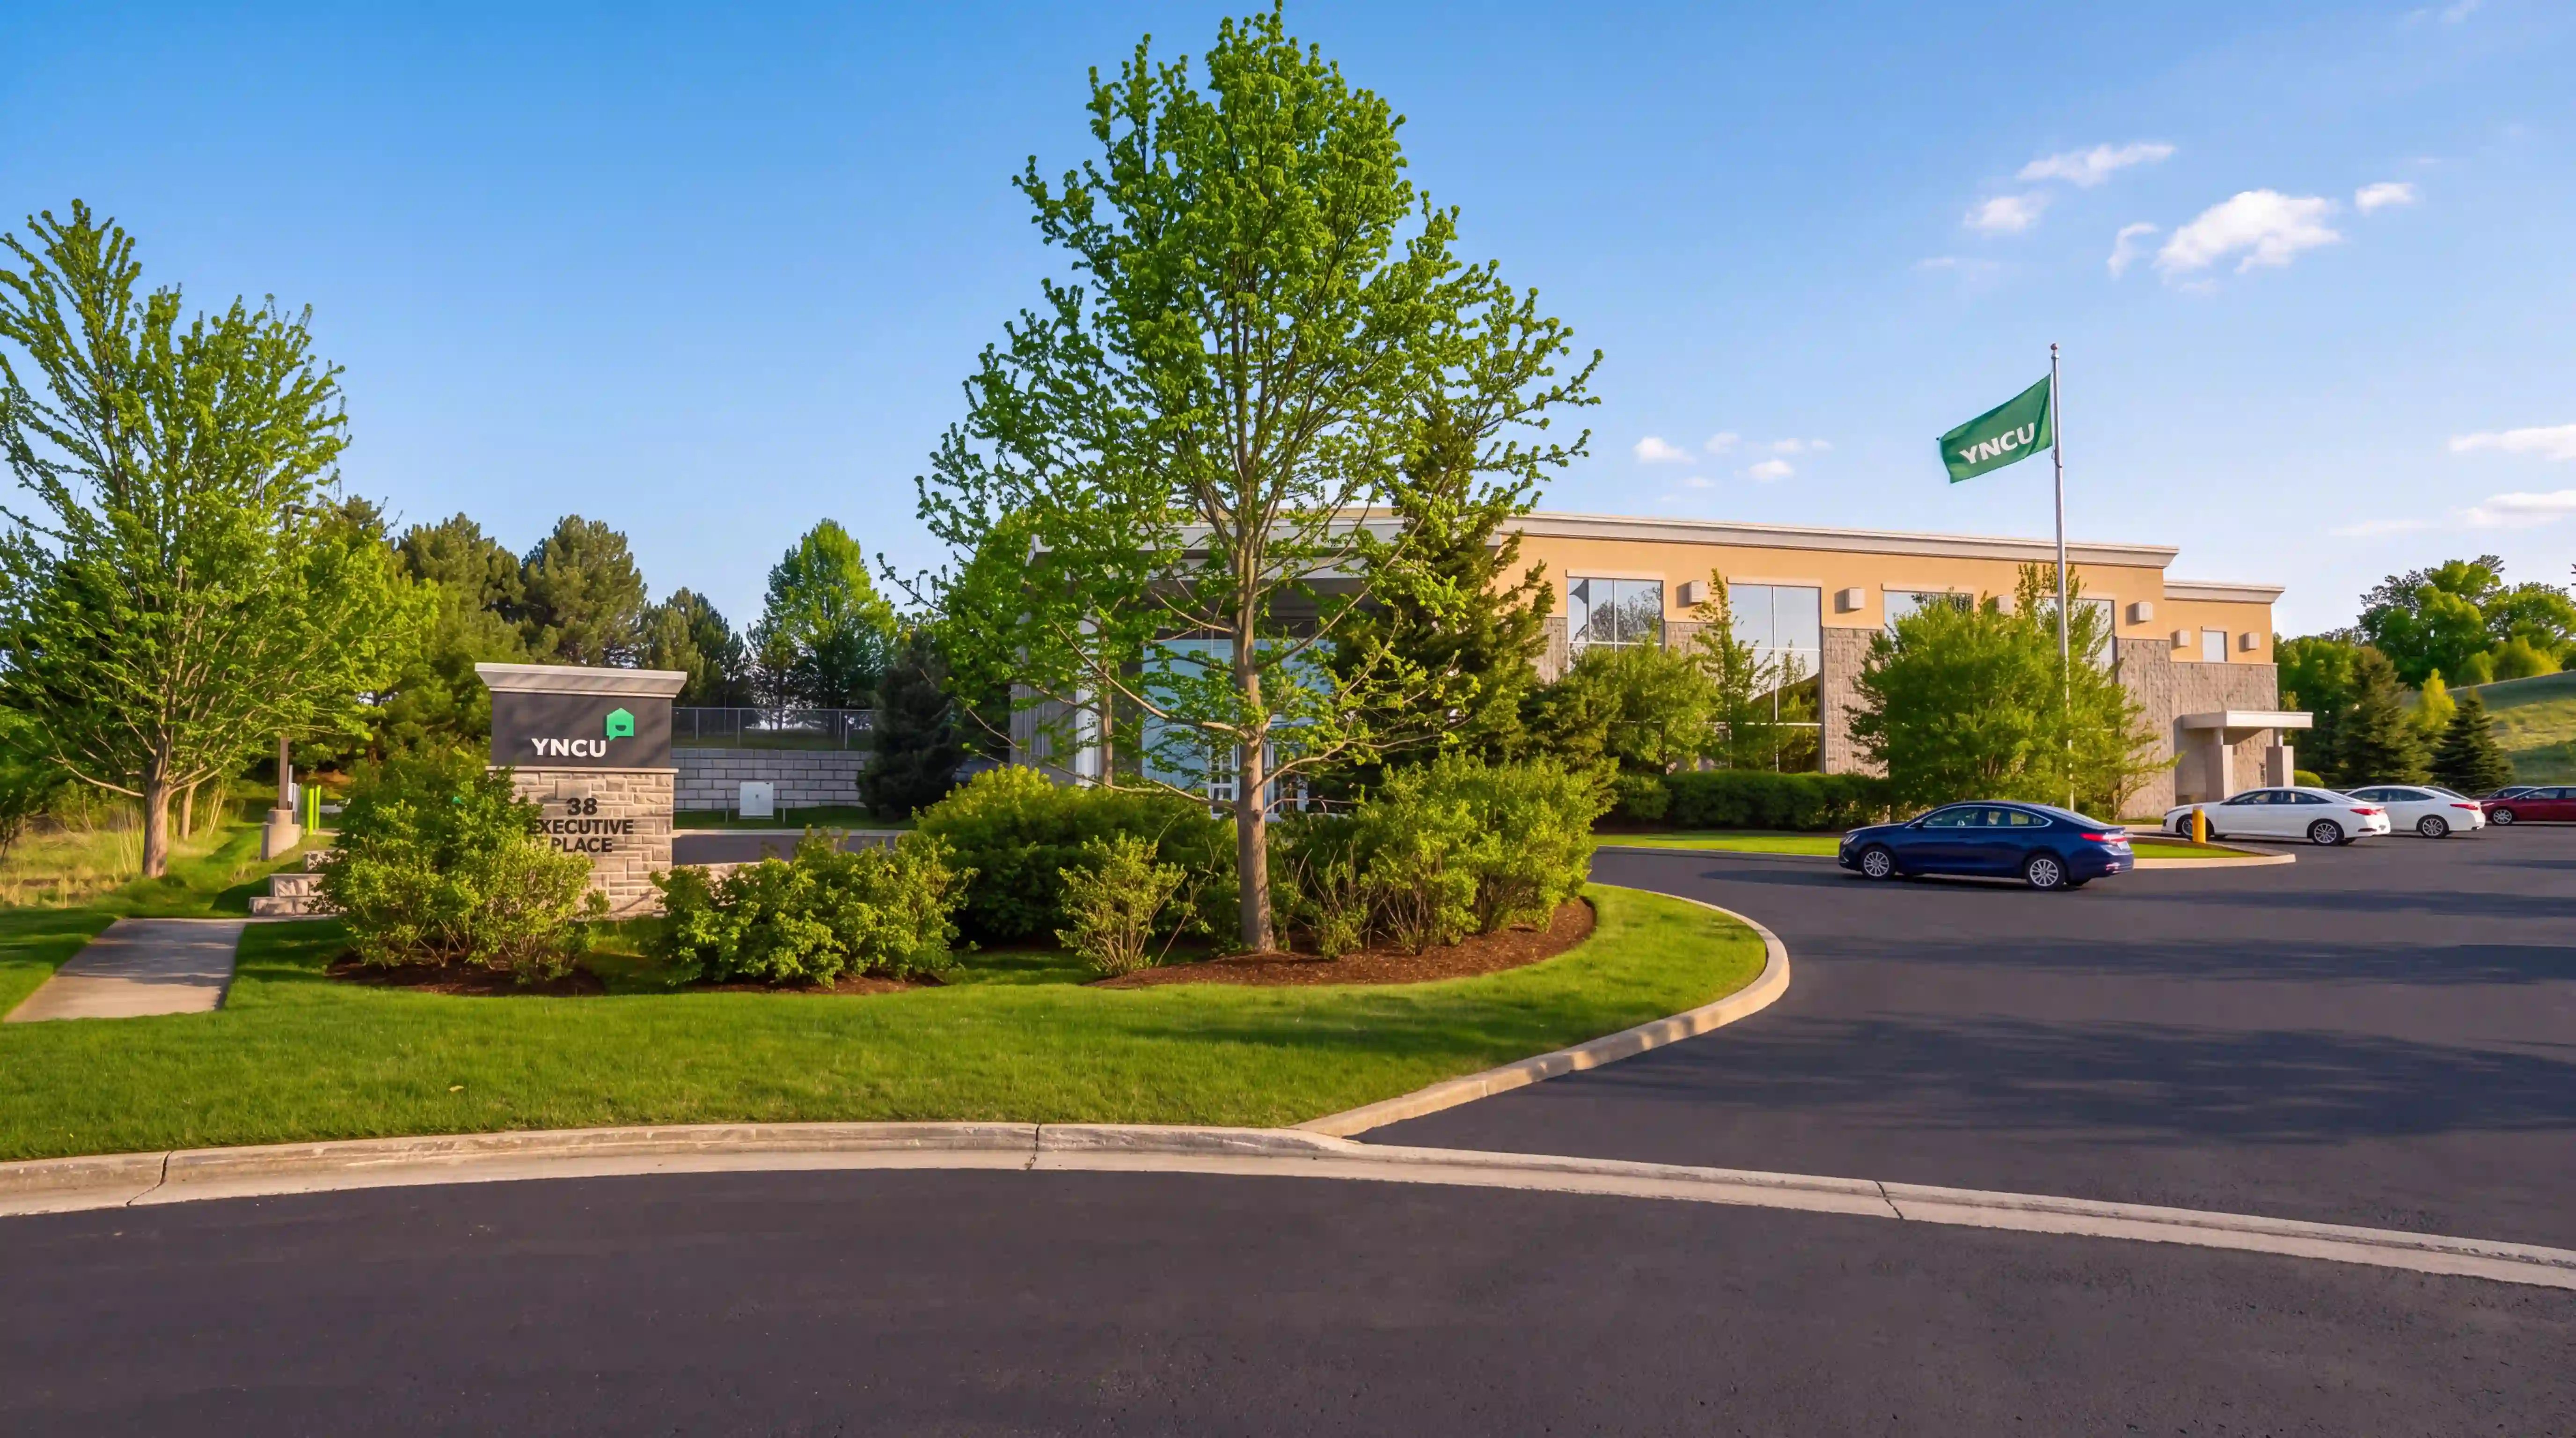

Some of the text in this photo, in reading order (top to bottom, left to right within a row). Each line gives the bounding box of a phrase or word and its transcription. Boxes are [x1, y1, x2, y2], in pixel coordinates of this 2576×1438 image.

[1959, 423, 2034, 464] YNCU
[531, 738, 607, 757] YNCU
[566, 797, 598, 815] 38
[550, 837, 612, 852] PLACE
